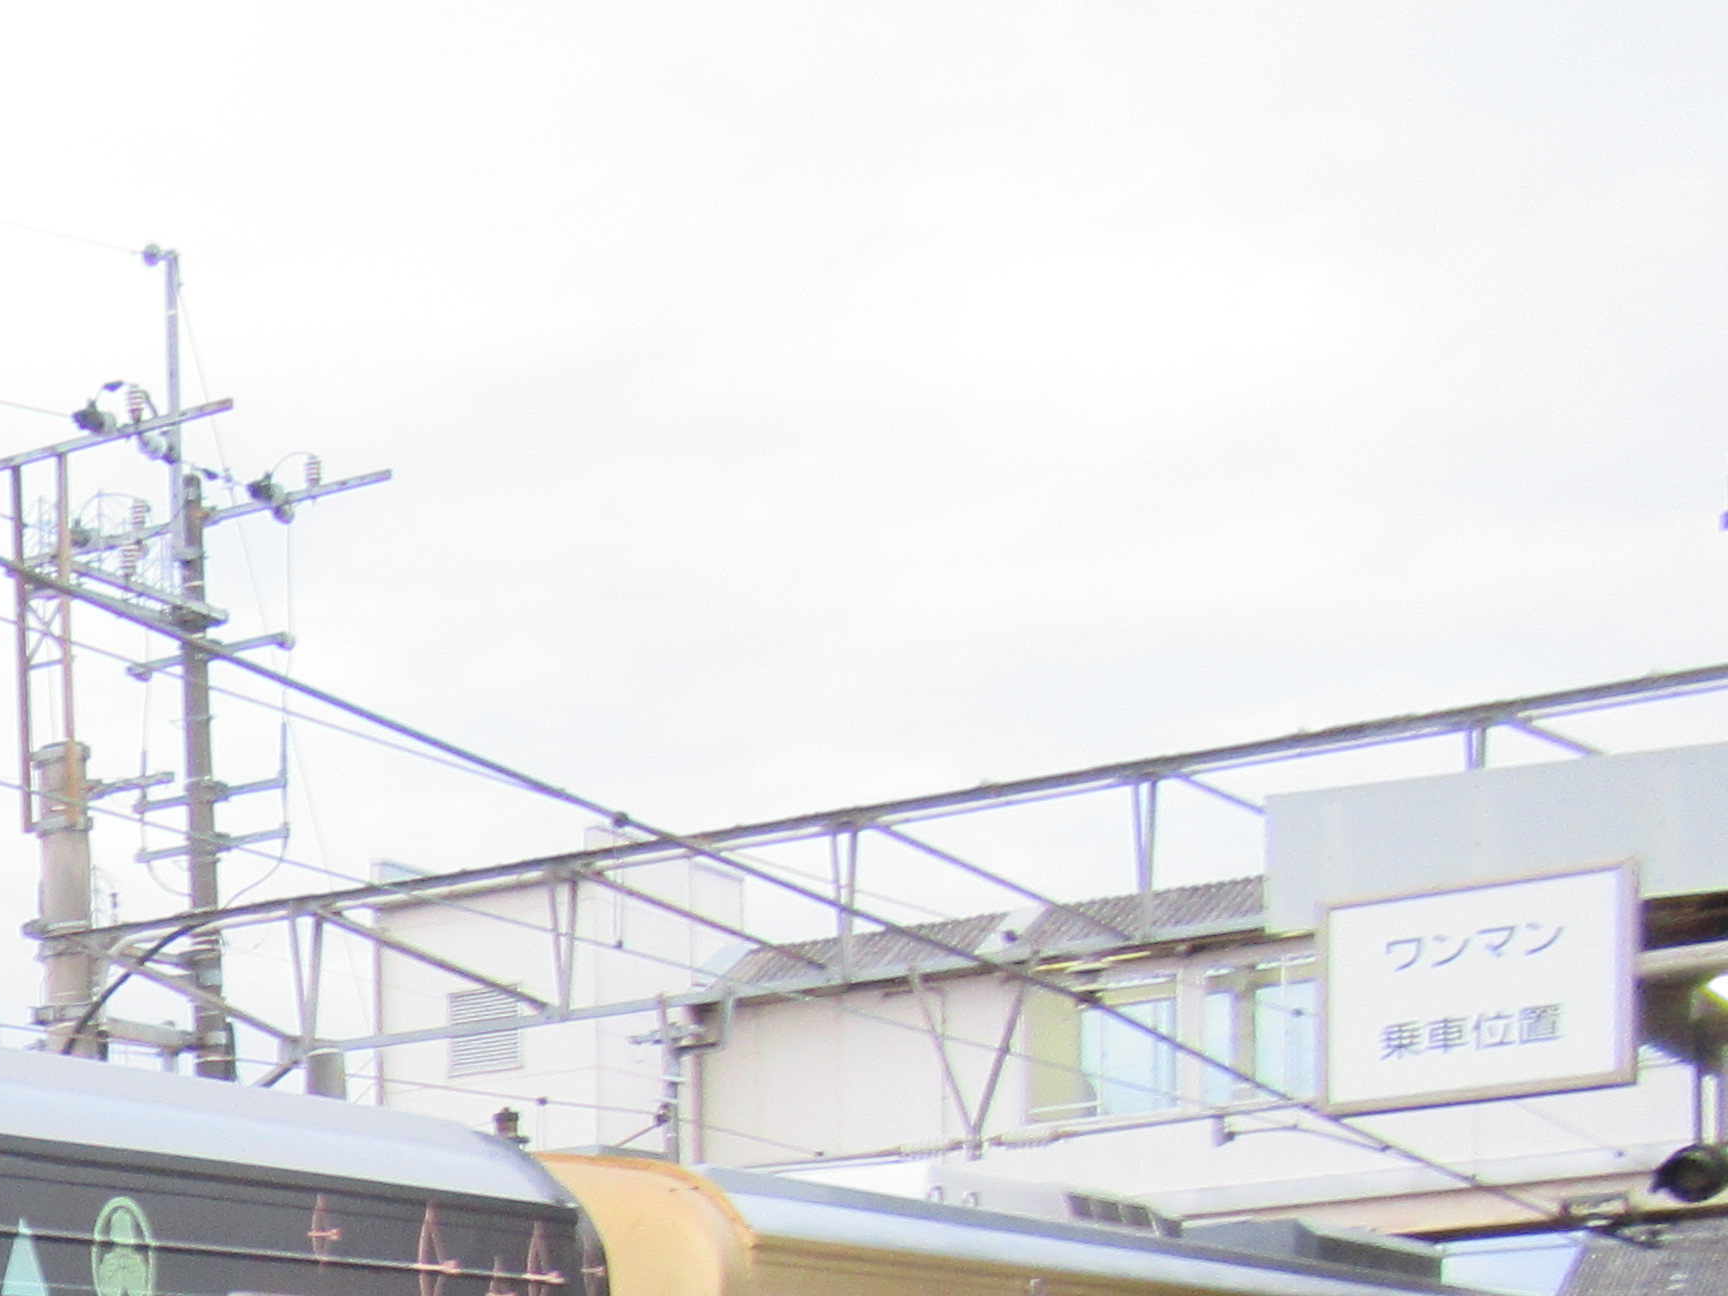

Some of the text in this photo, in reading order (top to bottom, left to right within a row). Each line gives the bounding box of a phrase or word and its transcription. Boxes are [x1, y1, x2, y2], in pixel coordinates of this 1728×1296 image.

[1384, 921, 1565, 972] ワンマン
[1379, 1003, 1562, 1062] 乗車位置
